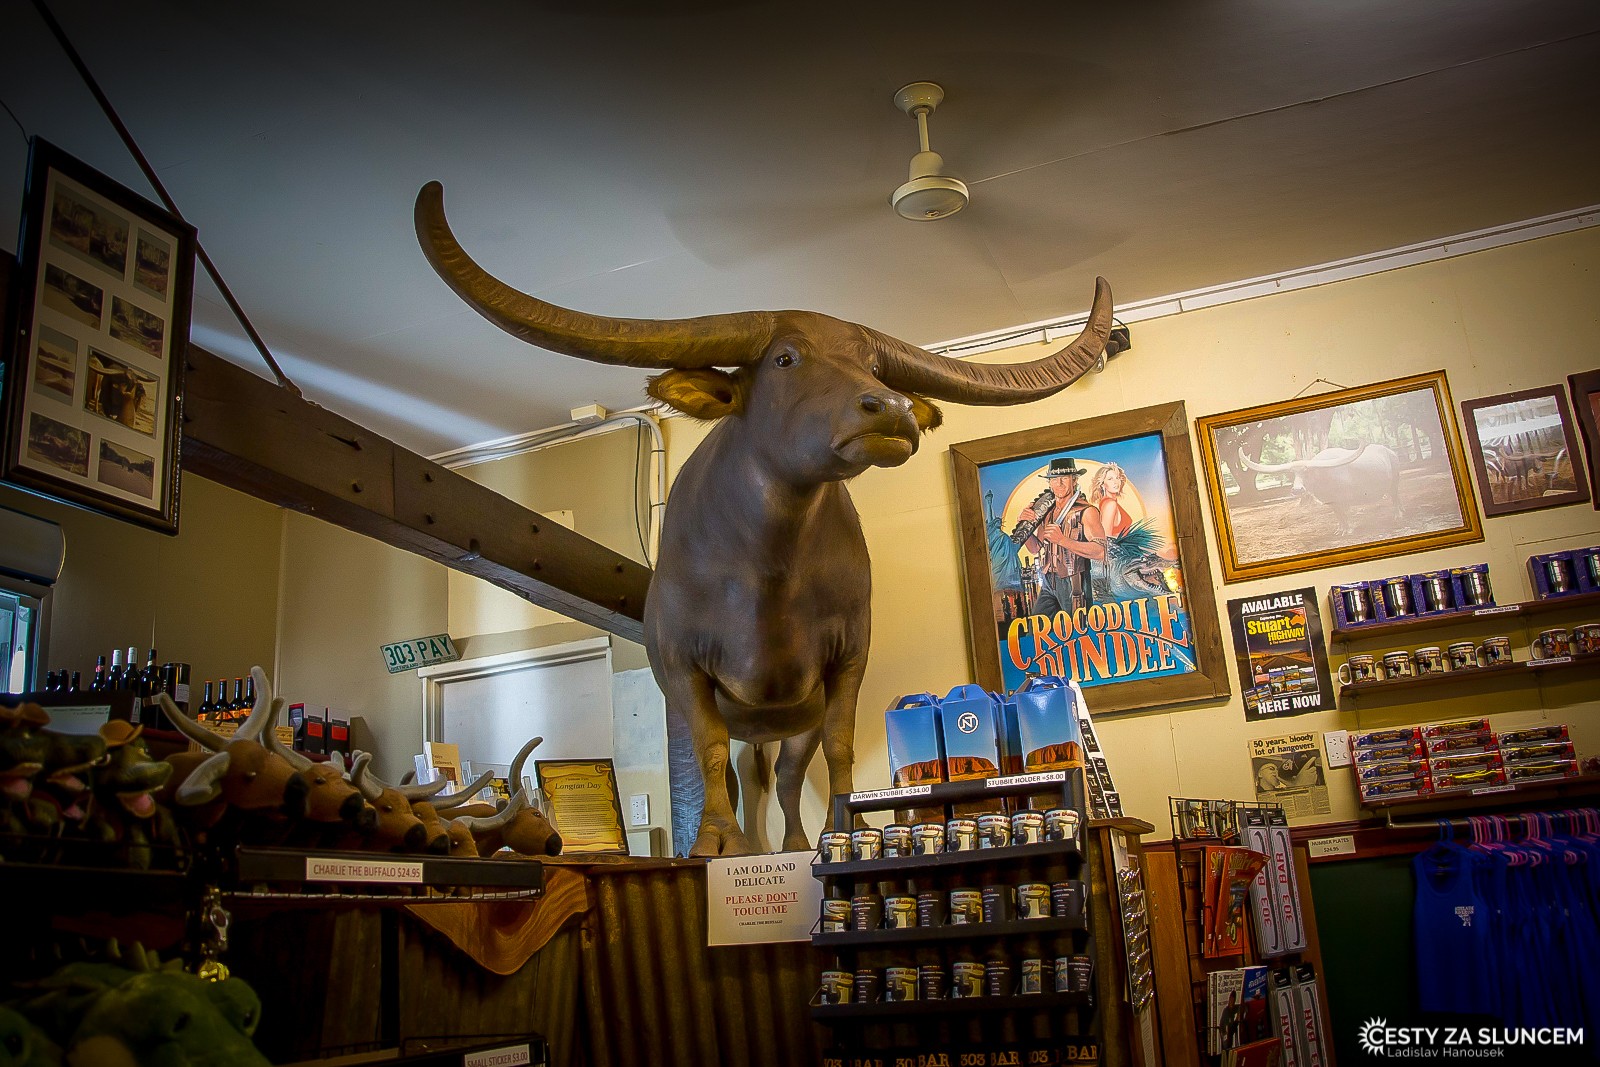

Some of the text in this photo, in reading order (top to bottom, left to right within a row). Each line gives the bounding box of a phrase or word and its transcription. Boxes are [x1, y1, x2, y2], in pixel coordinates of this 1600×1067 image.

[1241, 594, 1304, 614] AVAILABLE
[1007, 593, 1189, 671] CROCODILE
[1247, 616, 1292, 635] Stuart
[1267, 627, 1305, 642] HIGHWAY
[1035, 631, 1176, 683] DUNDEE
[1257, 698, 1290, 715] HERE
[1292, 693, 1321, 709] NOW
[1253, 733, 1314, 748] 50 years, bloody
[1254, 742, 1315, 756] lot of hangovers
[554, 781, 602, 791] Longtan Day
[988, 779, 1014, 787] STUBBIE
[1015, 776, 1040, 784] HOLDER
[852, 792, 878, 801] DARWIN
[878, 789, 904, 798] STUBBIE
[313, 864, 420, 878] CHARLIE THE BUFFALO $24.95
[727, 862, 796, 876] I AM OLD AND
[734, 876, 786, 888] DELICATE
[1275, 852, 1294, 924] 303 BAR
[725, 891, 799, 905] PLEASE DON'T
[733, 904, 788, 917] TOUCH ME
[1262, 896, 1273, 928] 303
[1280, 1014, 1293, 1050] BAR
[1303, 1008, 1316, 1043] BAR
[467, 1051, 528, 1067] SMALL STICKER $3.00
[918, 1053, 950, 1067] BAR
[960, 1052, 986, 1067] 303
